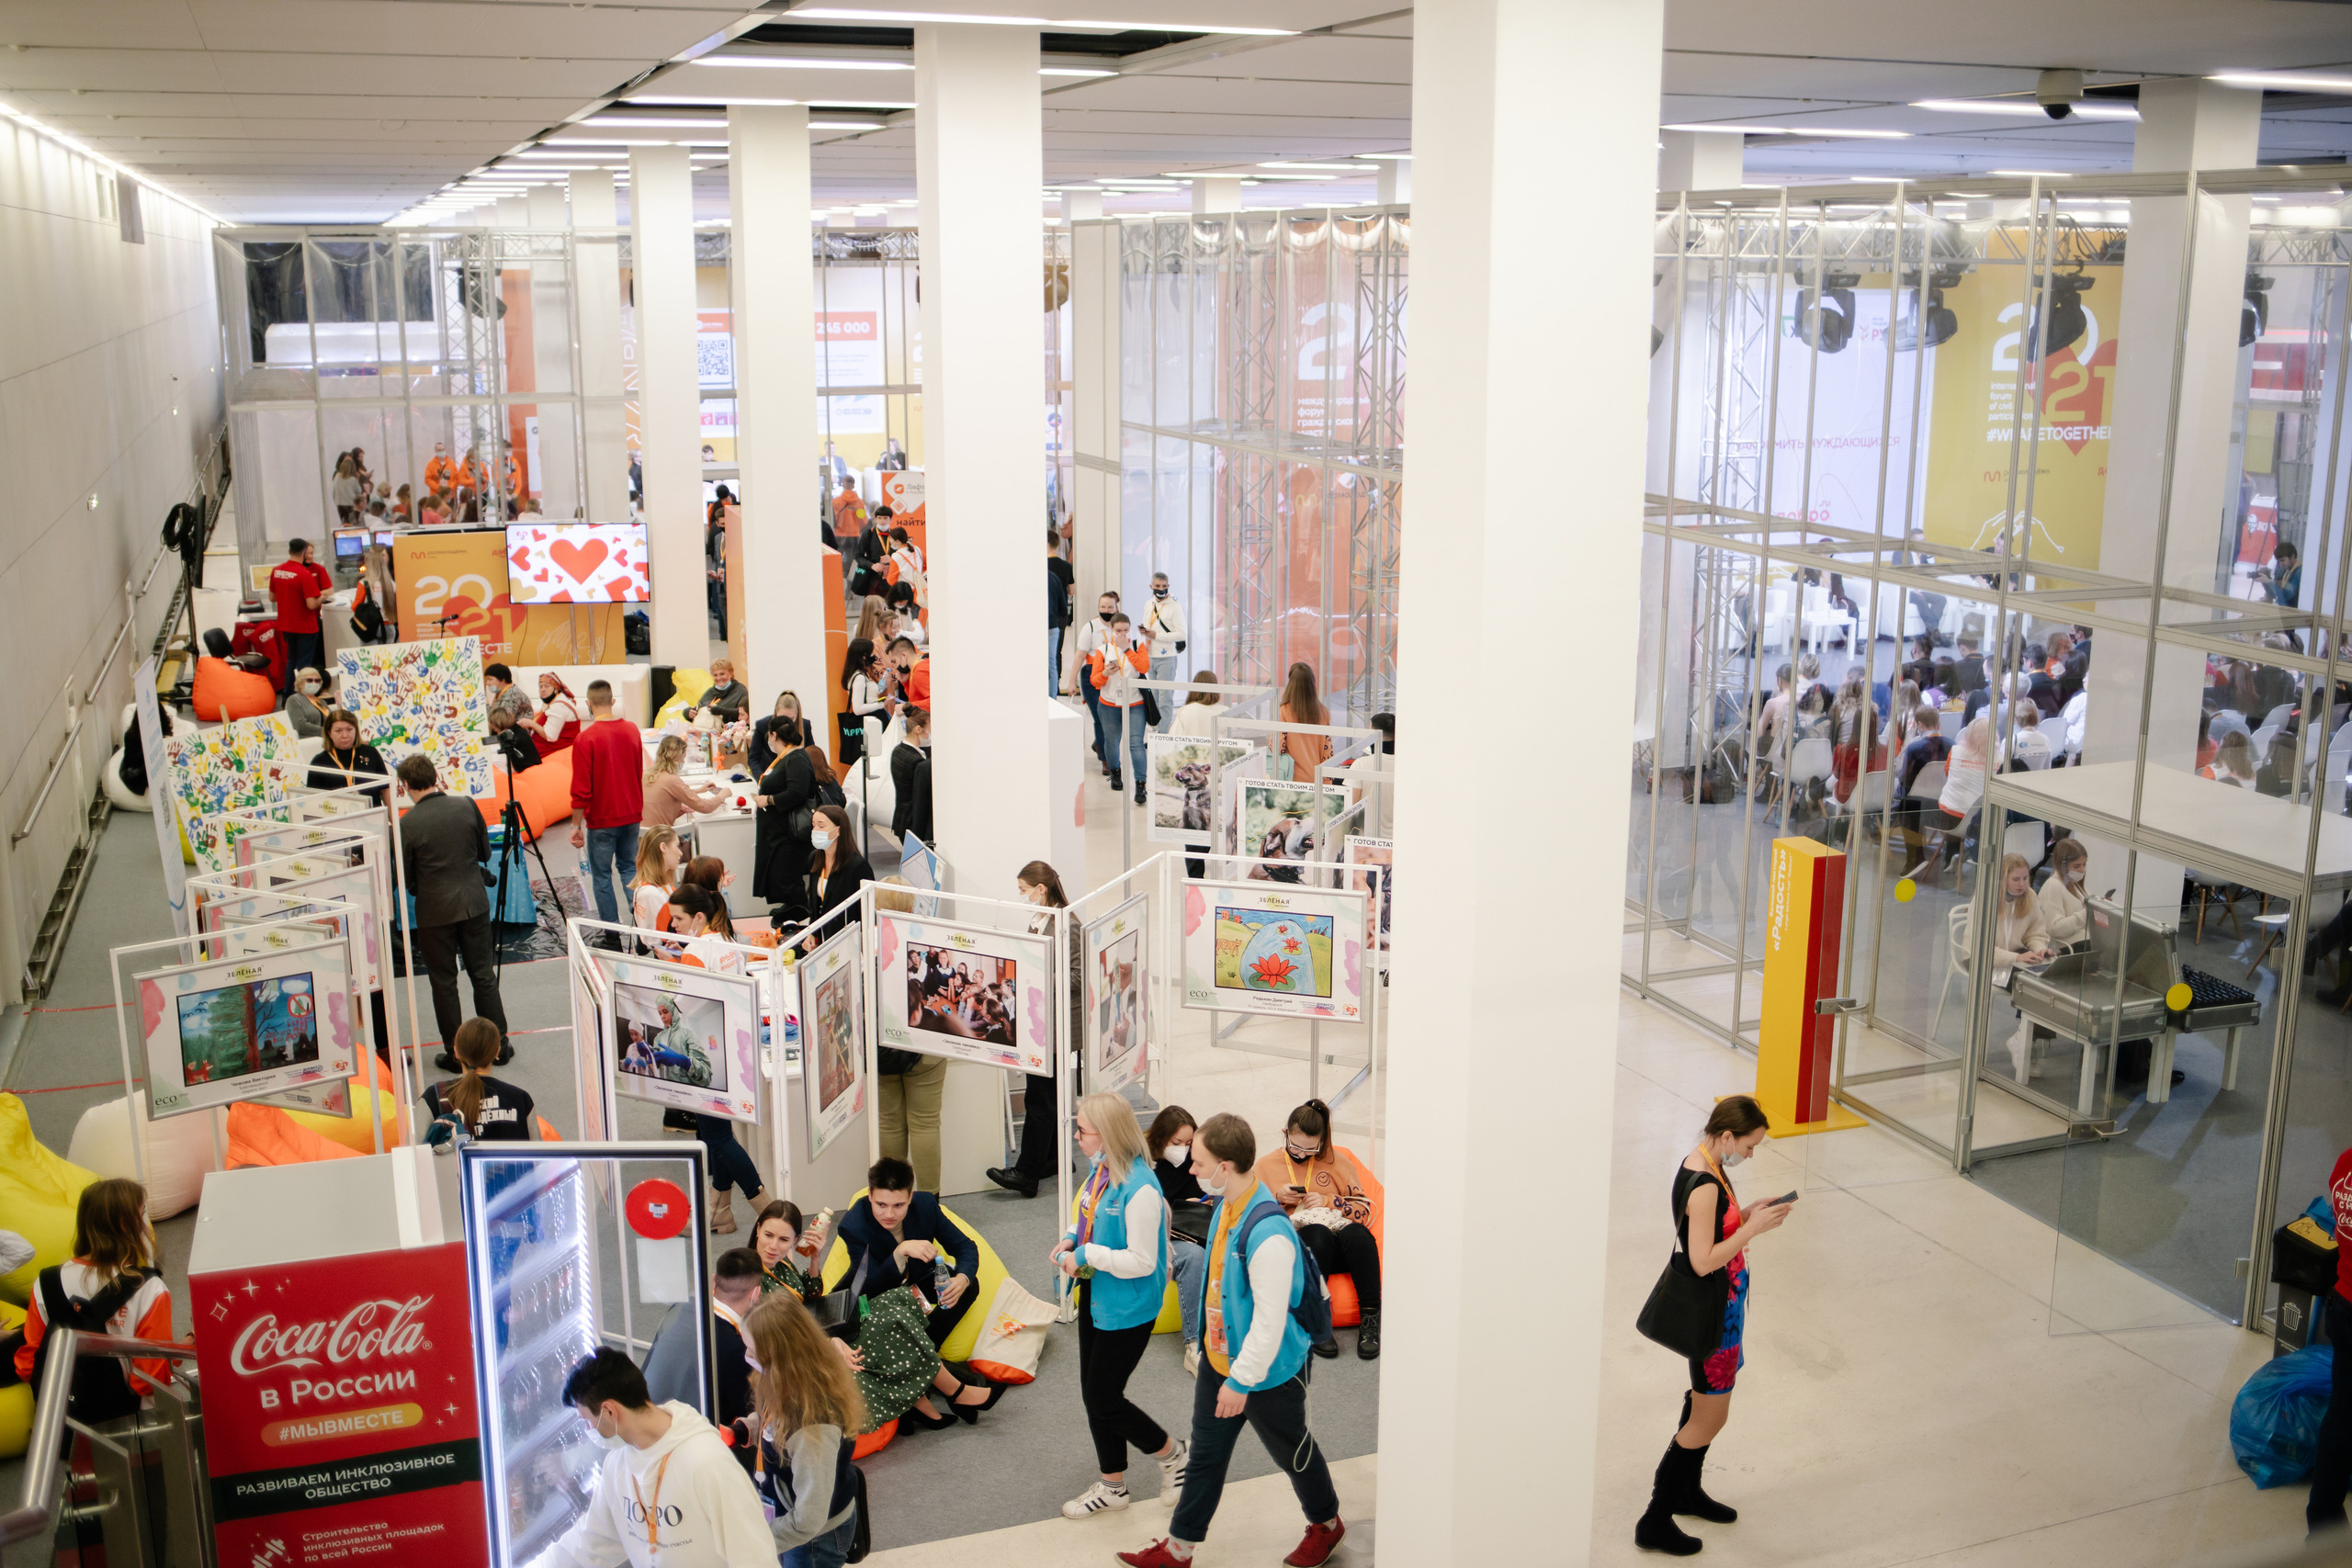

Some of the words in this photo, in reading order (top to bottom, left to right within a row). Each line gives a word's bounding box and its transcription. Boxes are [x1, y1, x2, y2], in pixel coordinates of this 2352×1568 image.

[843, 321, 870, 333] 000
[1991, 381, 2036, 390] internanal
[1989, 391, 2012, 400] forum
[1989, 400, 1997, 411] of
[1998, 400, 2013, 411] civil
[1988, 412, 2034, 422] participion
[1986, 425, 2111, 442] #WAETOGETHE
[1738, 439, 1804, 450] АКОМИТЬ
[1811, 436, 1900, 448] УЖДАЮЩИСЯ
[896, 516, 926, 526] найти
[414, 574, 492, 615] 20
[459, 606, 513, 642] 21
[480, 641, 513, 654] ЕСТЕ
[1286, 783, 1308, 791] ТВОИМ
[1308, 784, 1335, 793] ДГОМ
[1353, 838, 1376, 847] ГОТОВ
[1771, 849, 1786, 952] «Радость»
[1190, 990, 1208, 998] eco
[885, 1027, 902, 1037] eco
[154, 1095, 177, 1106] eco
[231, 1293, 434, 1375] Coca-Cola
[261, 1389, 280, 1408] в
[291, 1369, 415, 1404] России
[279, 1410, 403, 1440] #МЫВМЕСТЕ
[236, 1472, 331, 1496] РАЗВИВАЕМ
[335, 1453, 455, 1481] ИНКЛЮЗИВНОЕ
[305, 1477, 391, 1499] ОБЩЕСТВО
[623, 1496, 683, 1527] ДОРО
[302, 1521, 388, 1541] Строительство
[303, 1533, 383, 1551] инклюзивных
[386, 1522, 445, 1540] площадок
[305, 1554, 318, 1563] по
[322, 1548, 348, 1560] всей
[351, 1542, 392, 1556] России
